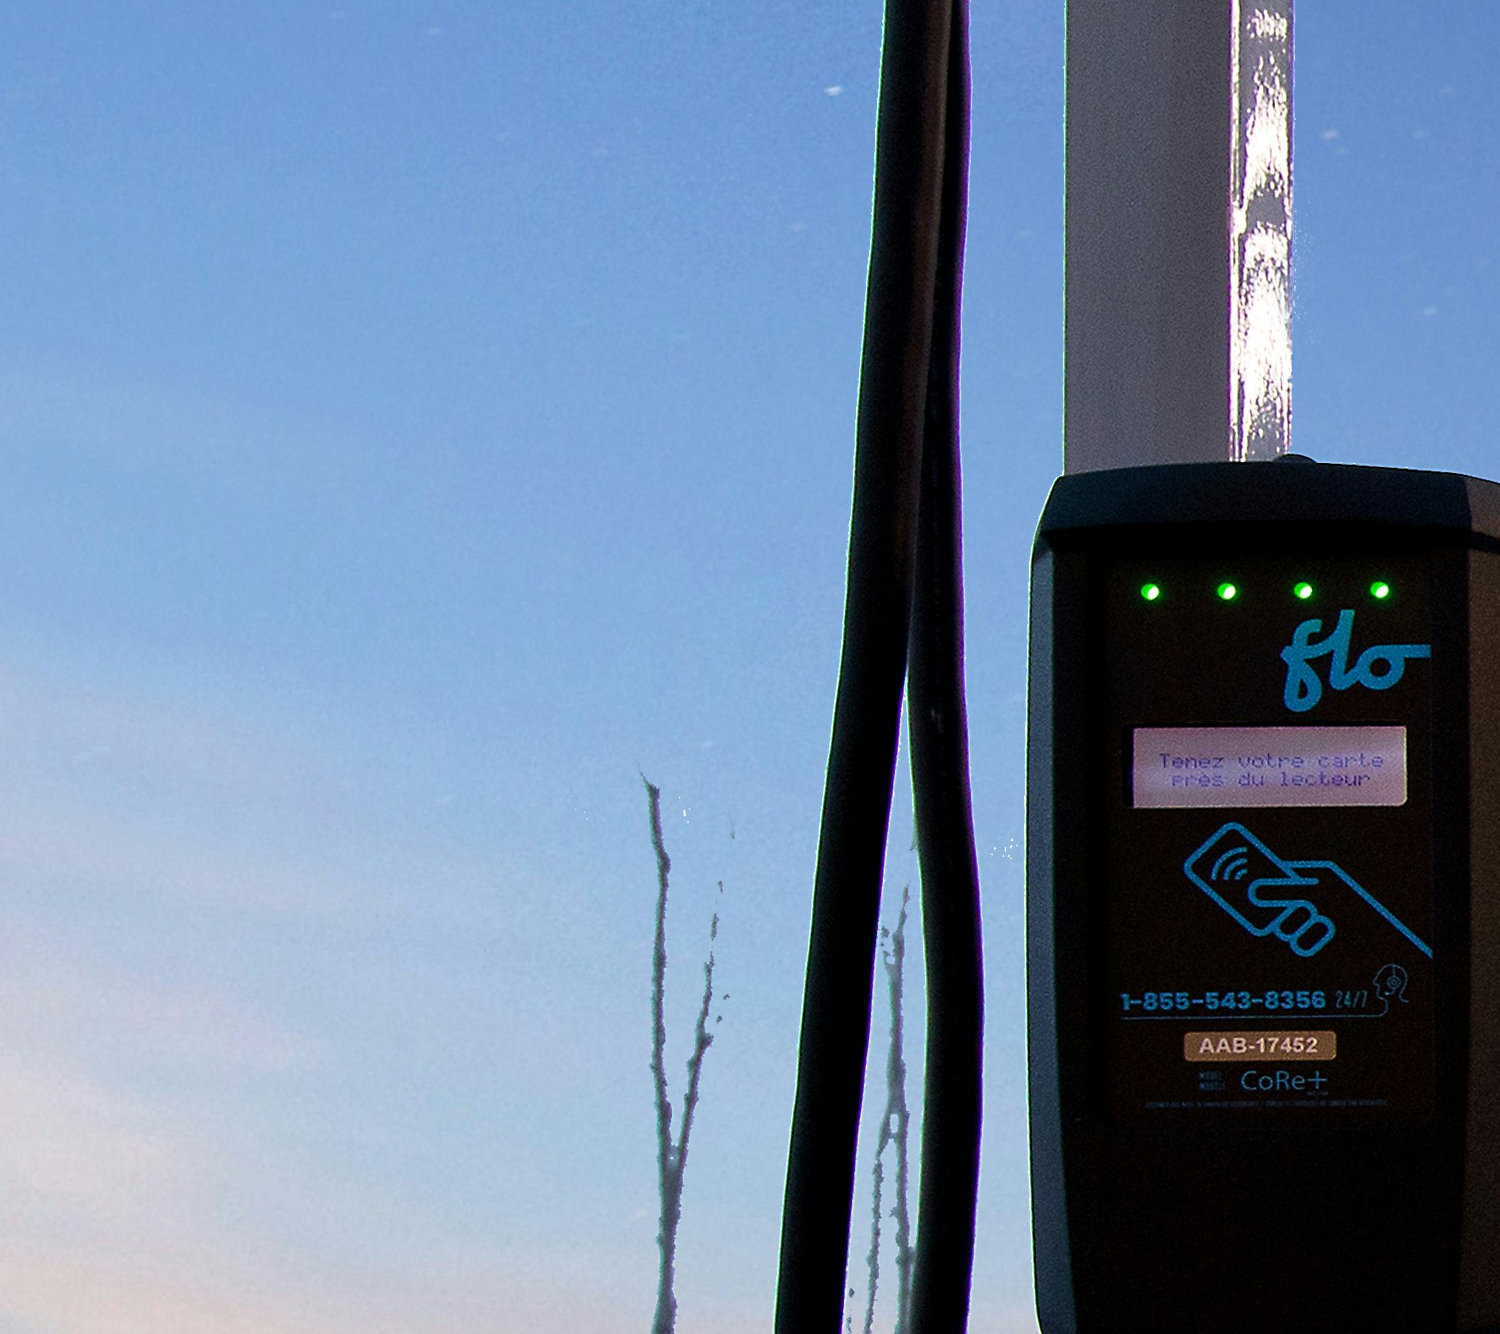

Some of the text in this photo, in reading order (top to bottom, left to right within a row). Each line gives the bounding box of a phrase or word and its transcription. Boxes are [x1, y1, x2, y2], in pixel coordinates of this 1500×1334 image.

[1280, 609, 1432, 712] flo
[1159, 752, 1384, 768] Tenez votre carte
[1238, 771, 1264, 787] du
[1280, 770, 1370, 787] lecteur
[1120, 989, 1368, 1011] 1-855-543-8356 24/7
[1199, 1037, 1318, 1054] AAB-17452
[1241, 1070, 1328, 1091] CoRe+
